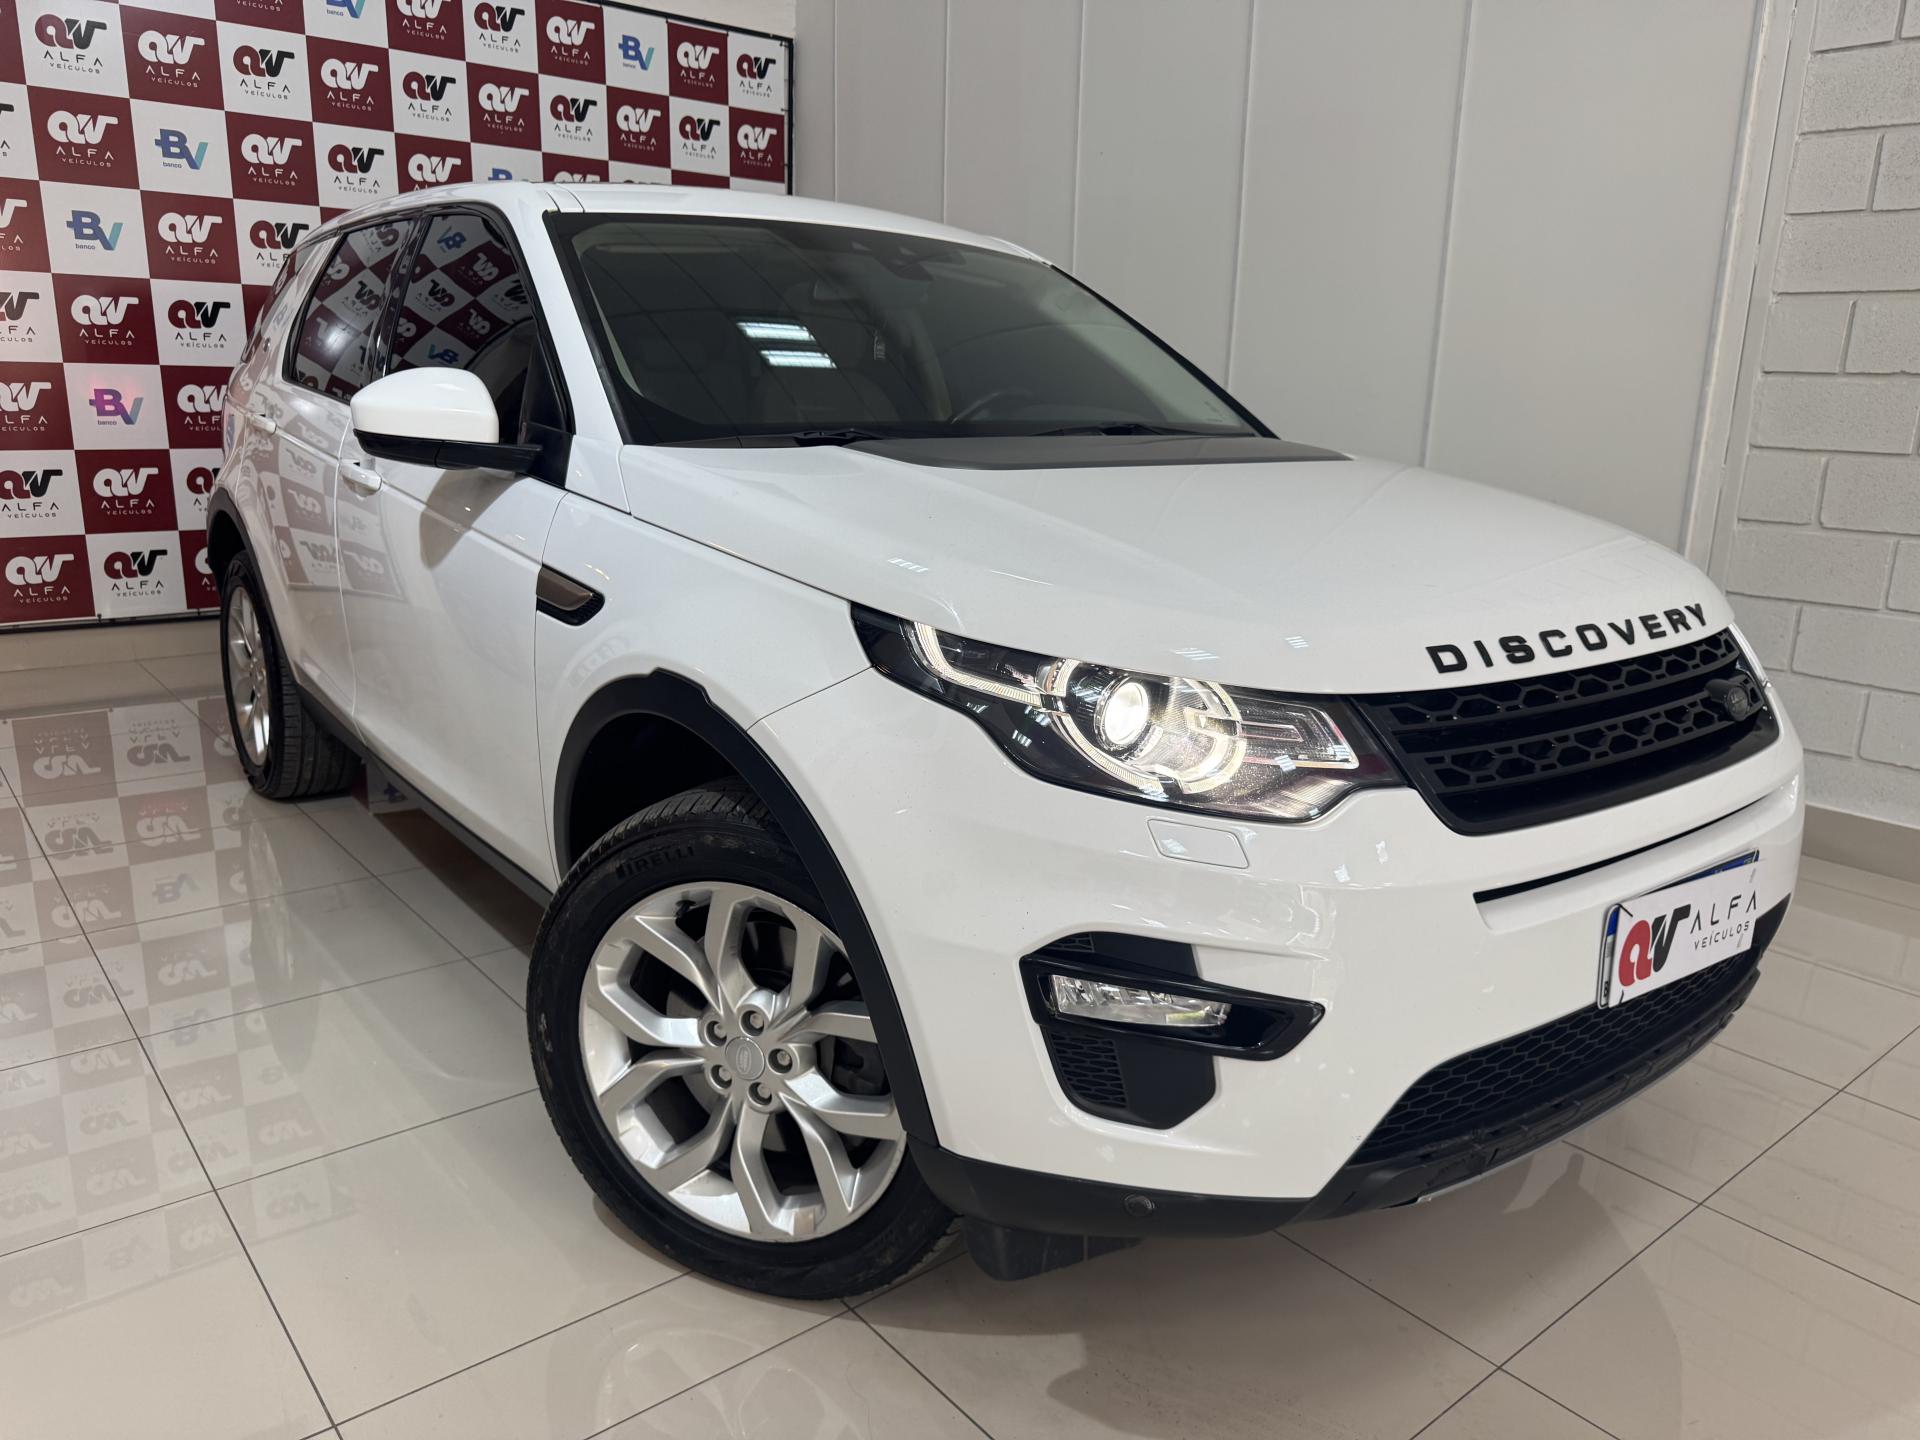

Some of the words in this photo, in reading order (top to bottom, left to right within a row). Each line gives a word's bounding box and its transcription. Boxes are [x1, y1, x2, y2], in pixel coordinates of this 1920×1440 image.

[402, 19, 447, 34] ALFA
[479, 32, 521, 47] ALFA
[44, 50, 103, 67] ALFA
[146, 65, 200, 80] ALFA
[240, 78, 291, 93] ALFA
[327, 90, 374, 105] ALFA
[408, 102, 452, 116] ALFA
[483, 113, 525, 127] ALFA
[56, 146, 114, 160] ALFA
[248, 167, 298, 180] ALFA
[334, 176, 380, 187] ALFA
[165, 246, 219, 257] ALFA
[256, 252, 290, 262] ALF
[79, 328, 135, 339] ALFA
[175, 332, 227, 342] ALFA
[184, 416, 220, 425] ALF
[2, 502, 59, 512] ALFA
[101, 499, 155, 509] ALFA
[14, 586, 71, 598] ALFA
[112, 580, 164, 591] ALFA
[1425, 603, 1707, 674] DISCOVERY
[1690, 890, 1757, 935] ALFA
[1694, 921, 1750, 950] VEÍCULOS
